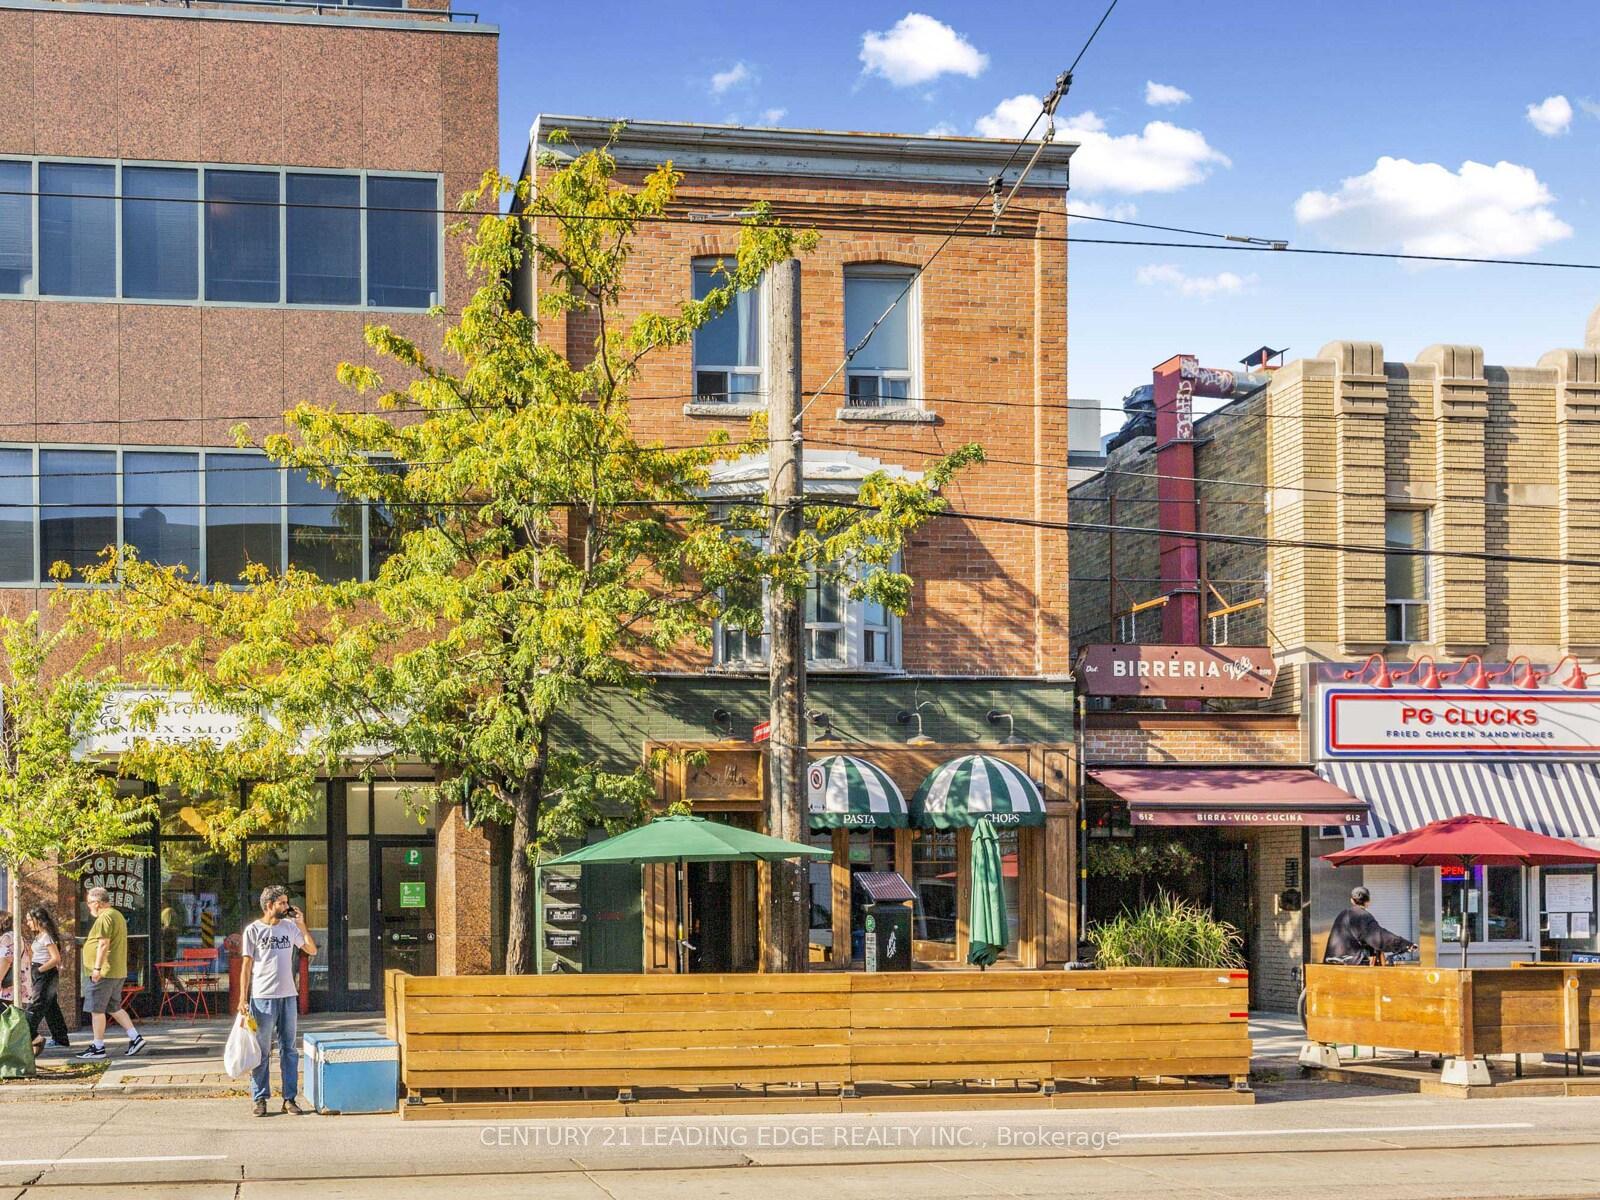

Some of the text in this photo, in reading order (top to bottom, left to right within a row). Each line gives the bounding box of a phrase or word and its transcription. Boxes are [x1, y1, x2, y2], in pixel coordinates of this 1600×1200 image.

[1402, 708, 1538, 725] PG CLUCKS
[1386, 730, 1554, 739] FRIED CHICKEN SANDWICHES
[843, 814, 876, 824] PASTA
[984, 813, 1020, 823] CHOPS
[1138, 813, 1154, 821] 612
[1265, 814, 1304, 822] CUCINA
[1440, 866, 1465, 875] OPEN
